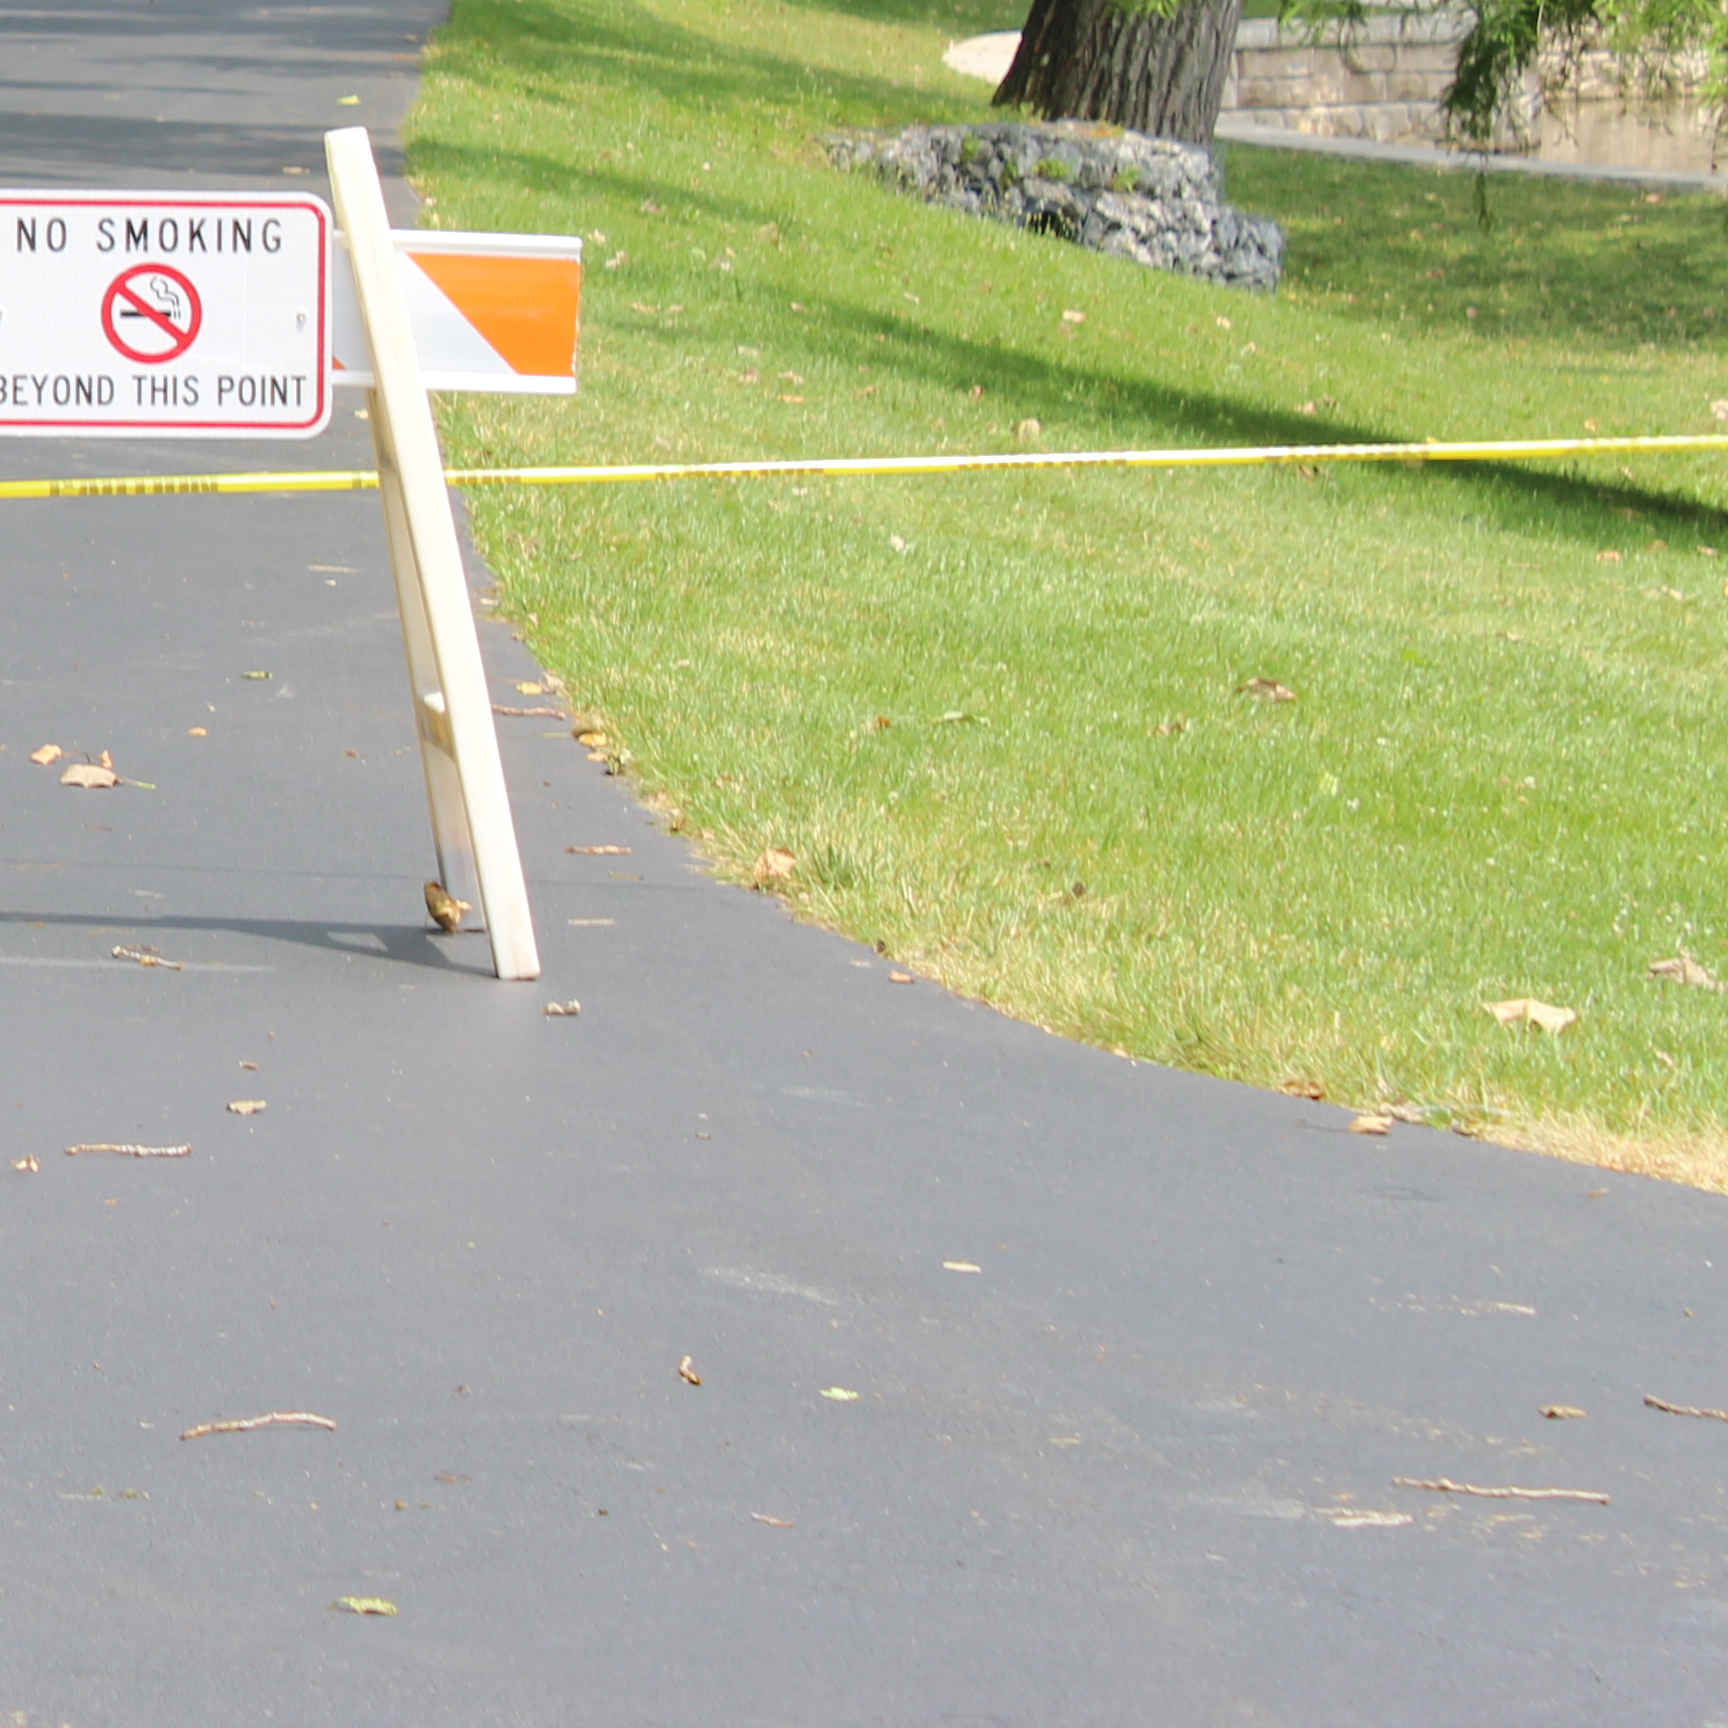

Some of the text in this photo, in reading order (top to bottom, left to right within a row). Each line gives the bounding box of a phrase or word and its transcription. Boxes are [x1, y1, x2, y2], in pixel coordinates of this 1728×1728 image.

[16, 217, 283, 254] NO SMOKING
[132, 375, 200, 407] THIS
[217, 375, 307, 407] POINT
